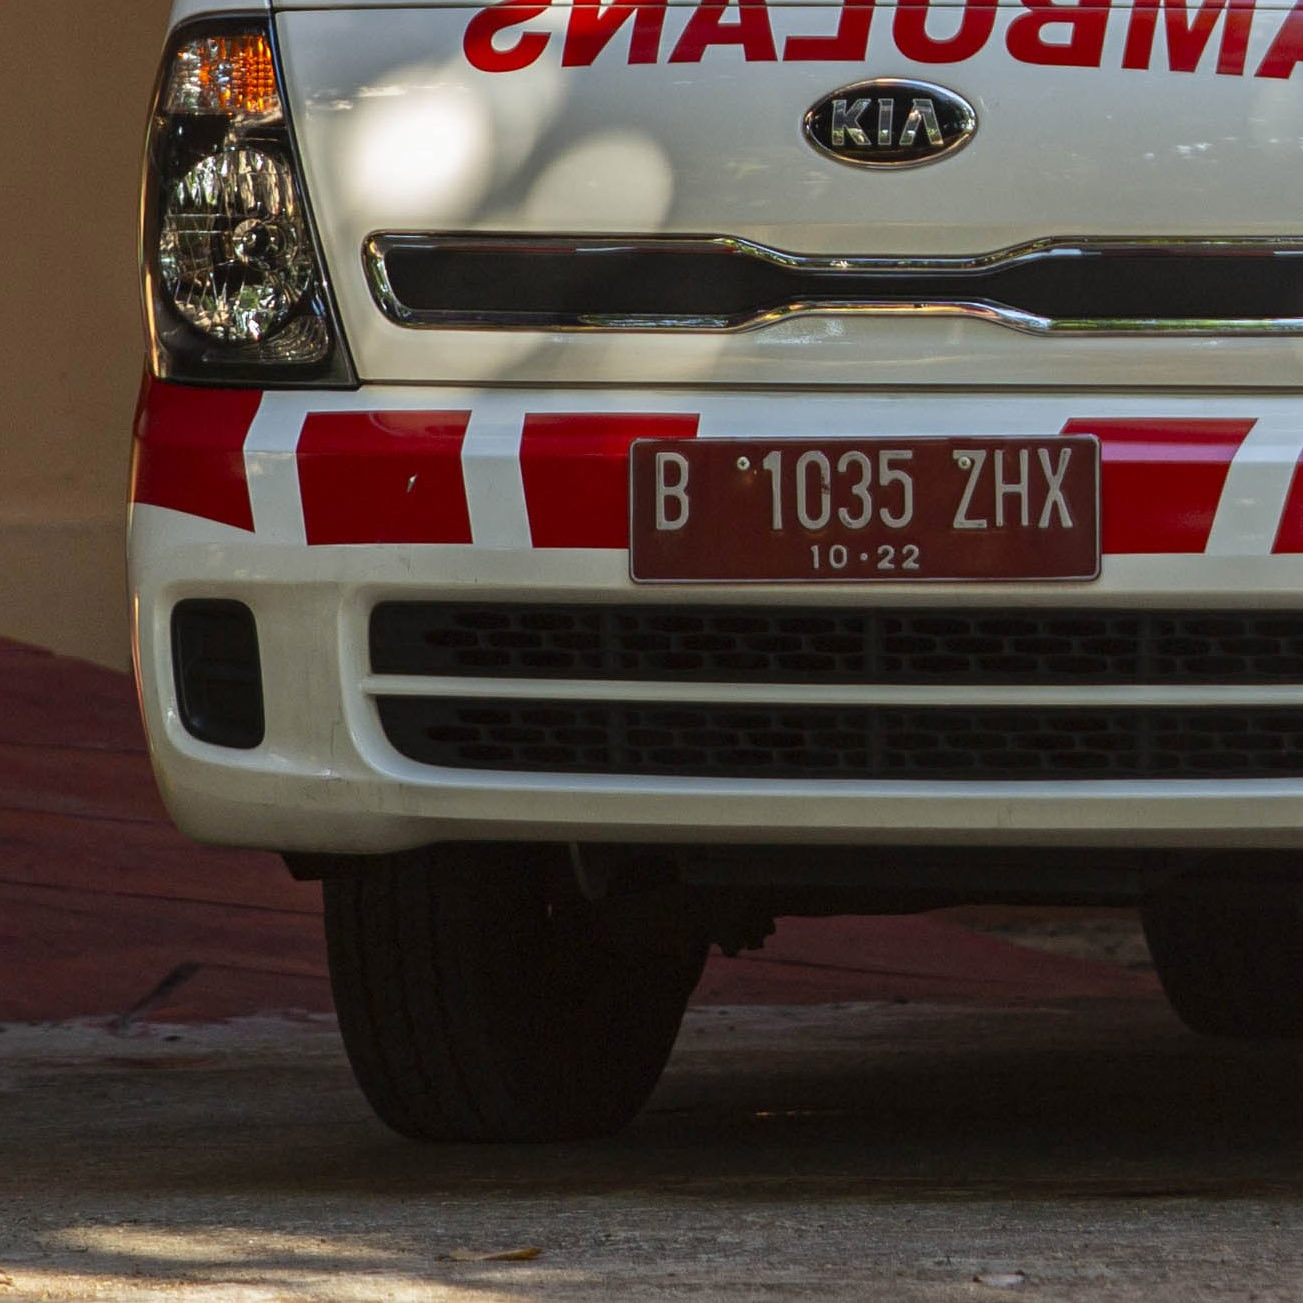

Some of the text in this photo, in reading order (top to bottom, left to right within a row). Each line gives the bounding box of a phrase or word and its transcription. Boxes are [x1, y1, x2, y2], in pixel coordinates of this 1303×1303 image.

[830, 96, 946, 149] KIA
[655, 447, 1074, 532] B 1035 ZHX
